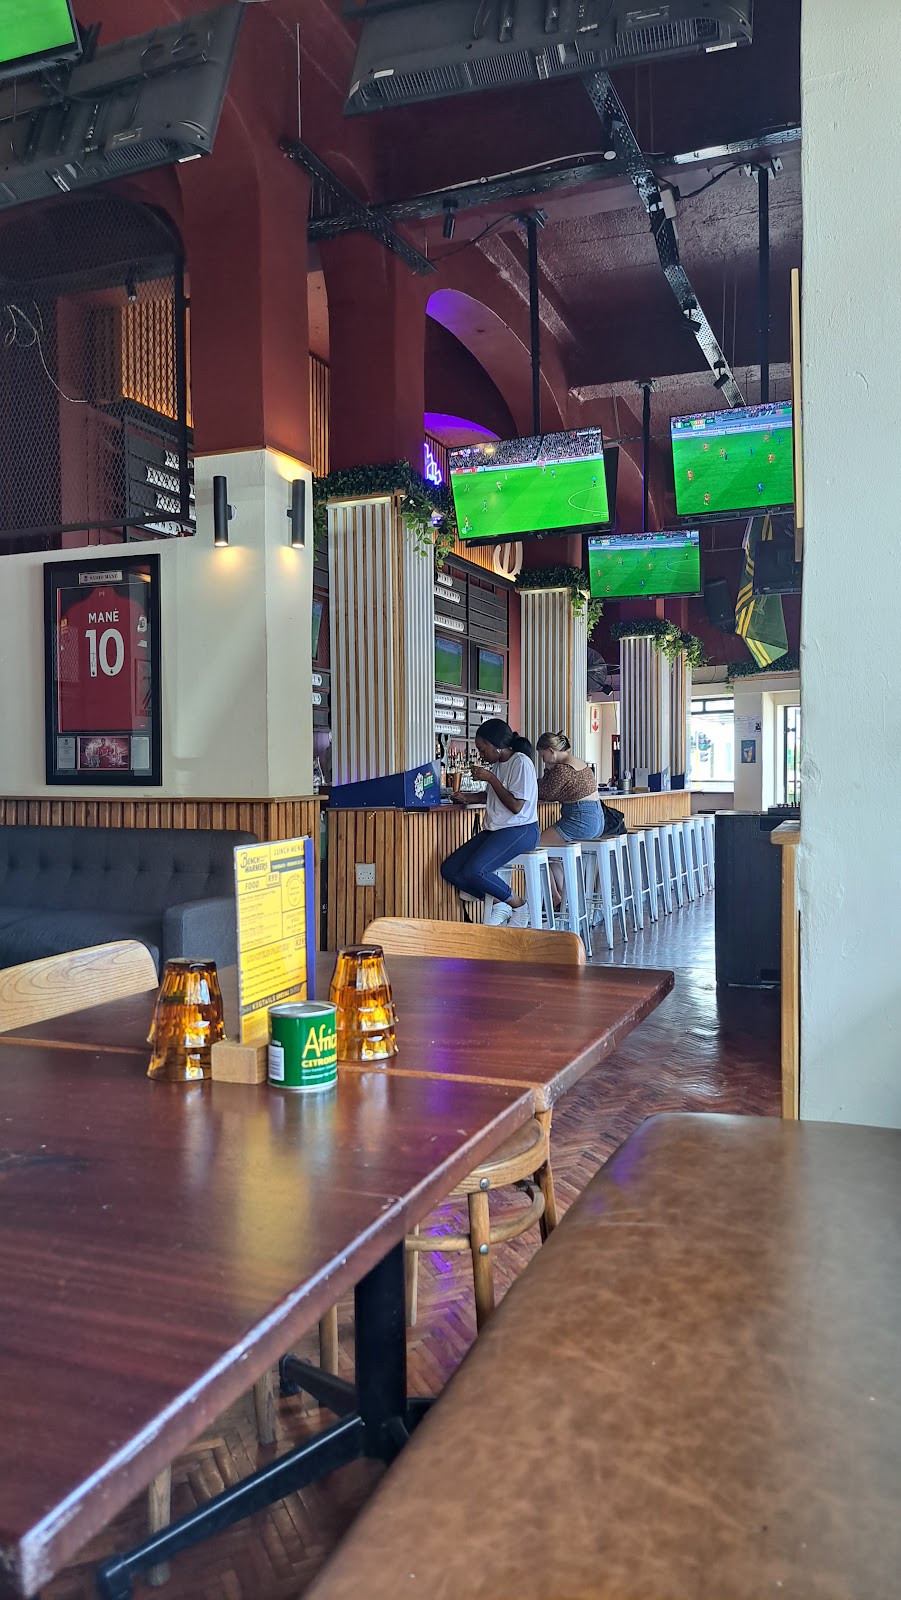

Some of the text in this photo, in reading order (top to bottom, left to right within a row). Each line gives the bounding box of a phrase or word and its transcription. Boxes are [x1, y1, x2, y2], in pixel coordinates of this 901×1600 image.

[88, 608, 119, 624] MANÉ
[85, 628, 124, 678] 10
[274, 847, 289, 856] LUNCH
[245, 881, 259, 890] FOOD
